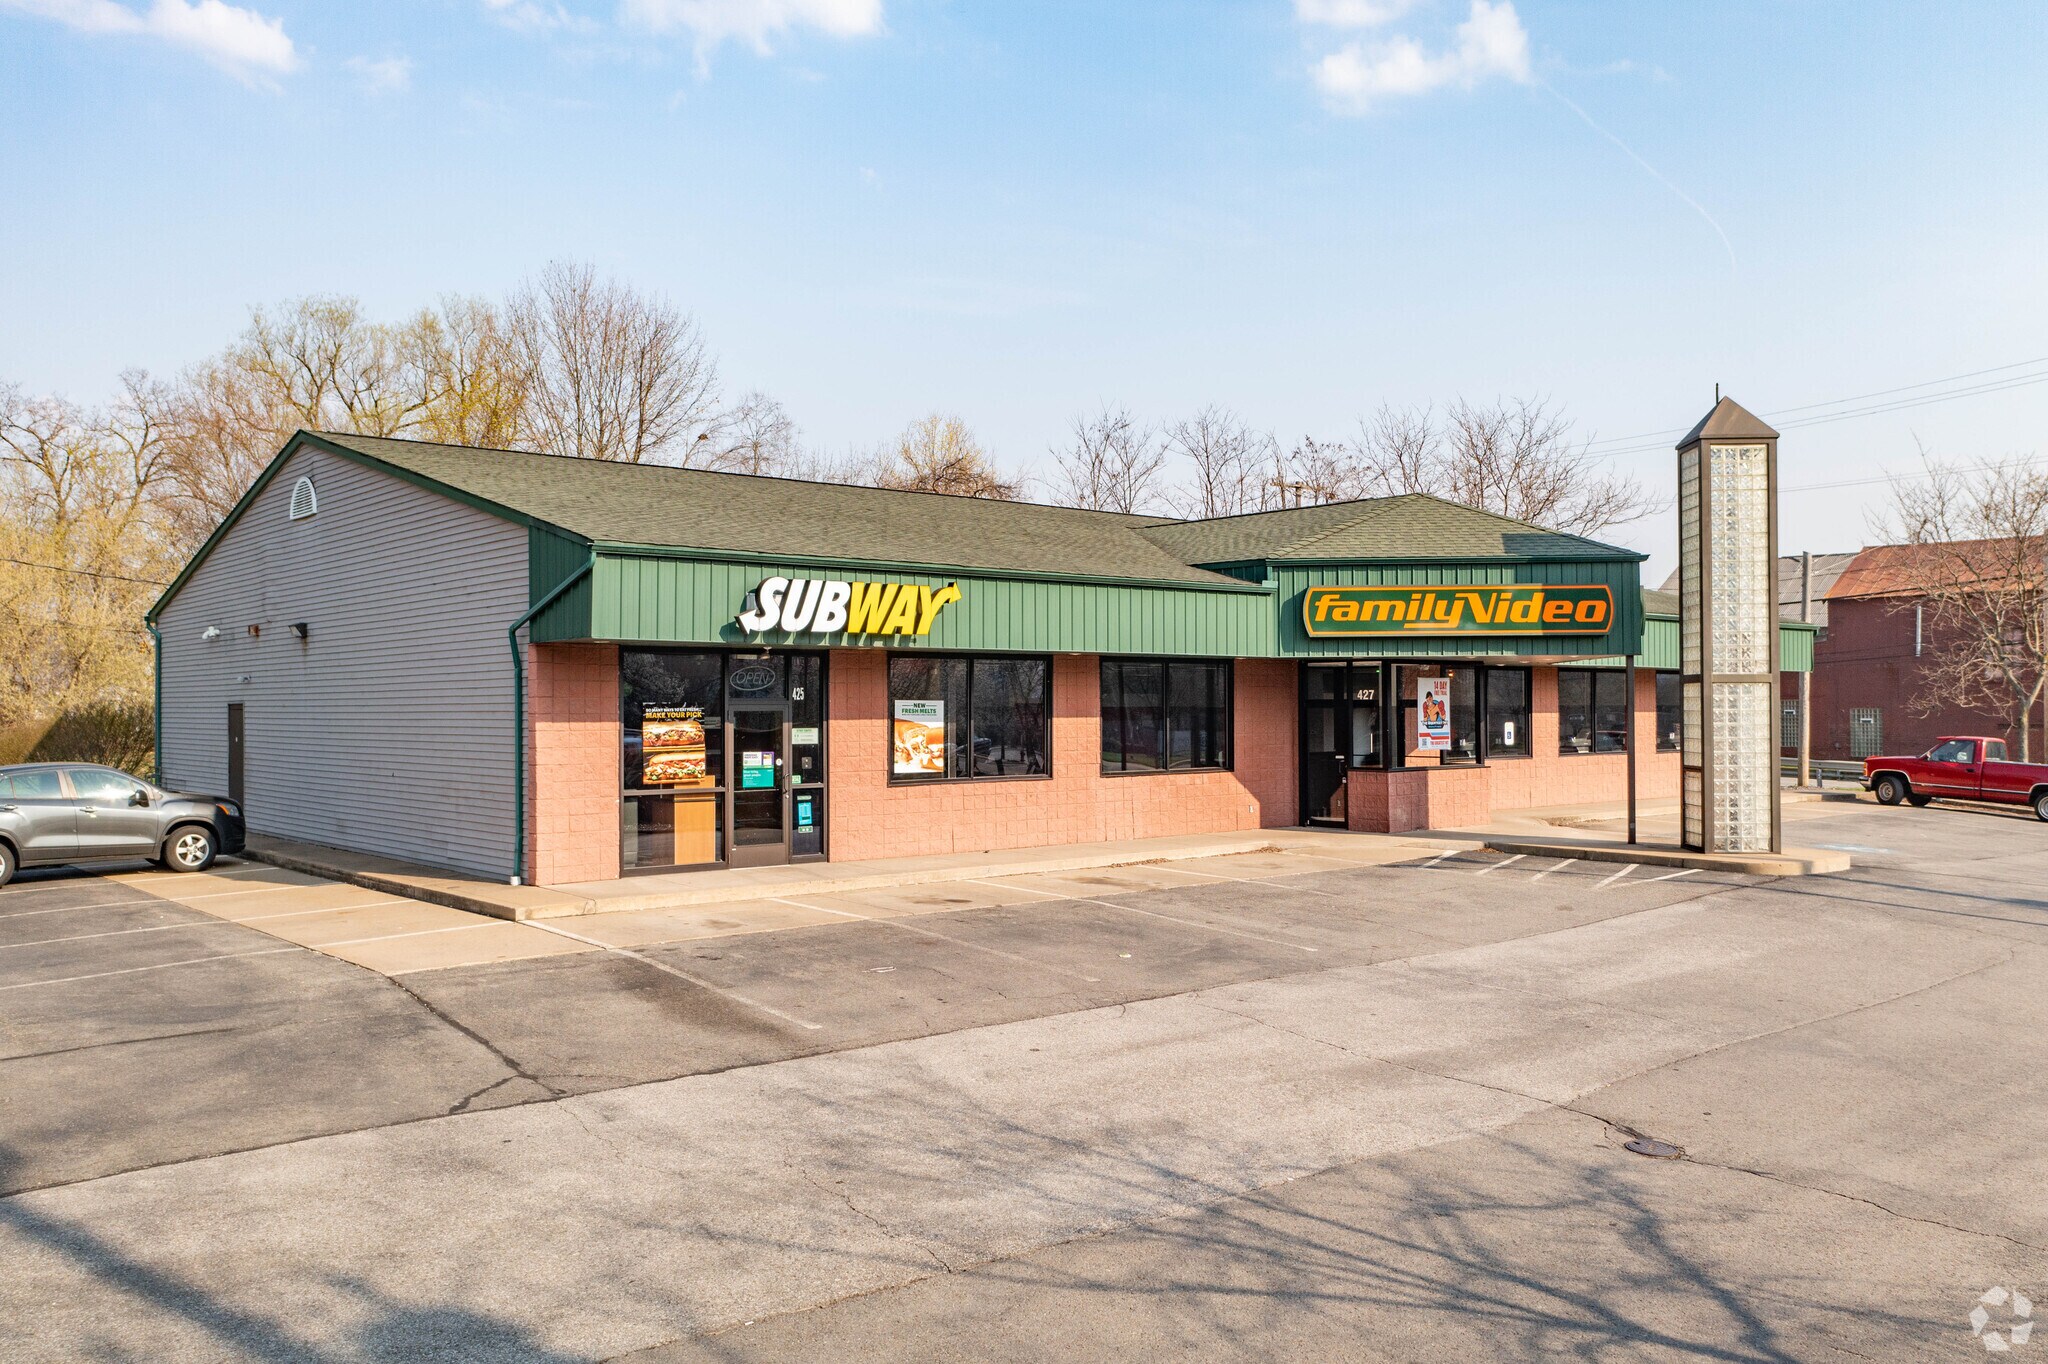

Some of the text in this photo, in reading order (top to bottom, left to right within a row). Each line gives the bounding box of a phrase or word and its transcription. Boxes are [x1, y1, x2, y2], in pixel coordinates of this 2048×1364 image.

[735, 577, 962, 635] SUBWAY
[736, 671, 769, 684] OPEN
[792, 687, 805, 700] 425
[1357, 689, 1375, 700] 427
